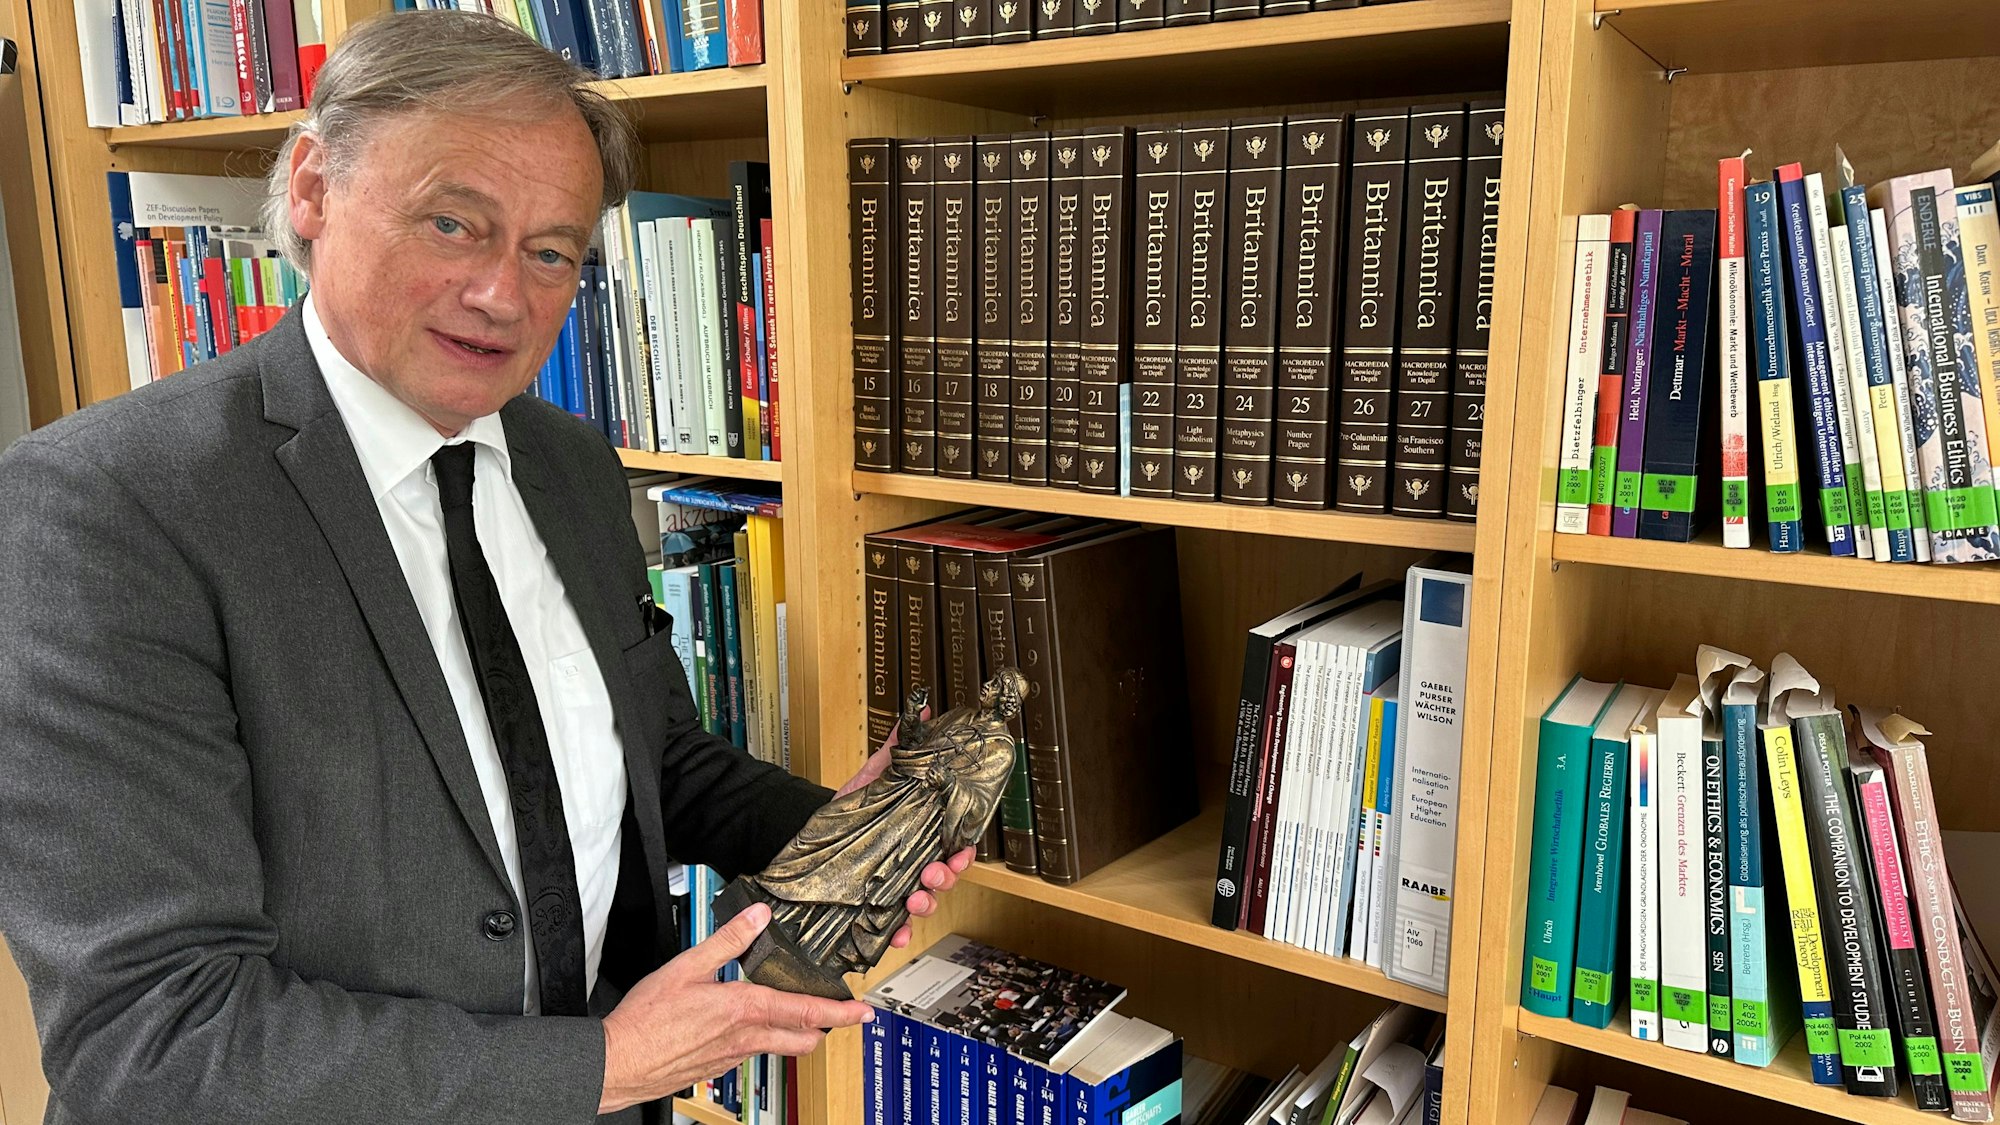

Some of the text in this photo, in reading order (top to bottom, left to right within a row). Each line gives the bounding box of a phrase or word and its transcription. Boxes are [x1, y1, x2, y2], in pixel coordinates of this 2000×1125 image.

[146, 204, 220, 214] ZEF-Discussion Papers
[1754, 191, 1771, 204] 19
[1849, 193, 1866, 206] 25
[158, 213, 201, 223] Development
[203, 214, 223, 223] Policy
[1727, 177, 1736, 255] Kampmann/Siebe/Walter
[1917, 194, 1937, 251] ENDERLE
[734, 184, 749, 303] Geschäftsplan Deutschland
[1359, 180, 1391, 330] Britannica
[1417, 177, 1449, 330] Britannica
[1020, 195, 1039, 325] Britannica
[1145, 190, 1169, 327] Britannica
[1190, 189, 1215, 328] Britannica
[1240, 187, 1267, 329] Britannica
[1295, 183, 1325, 329] Britannica
[1790, 202, 1817, 328] Kreikebaum/Behnam/Gilbert
[1579, 251, 1594, 354] Unternehmensethik
[1757, 230, 1778, 377] Unternehmensethik in der Praxis
[1856, 218, 1884, 384] Globalisierung, Ethik und Entwicklung
[1629, 231, 1655, 421] Held, Nutzinger: Nachhaltiges Naturkapital
[1669, 234, 1694, 401] Dettmar: Markt Macht Moral
[649, 314, 662, 381] DER BESCHLUSS
[1728, 261, 1739, 418] Mikroökonomie: Markt und Wettbewerb
[769, 360, 779, 383] Erwin
[1926, 274, 1965, 485] International Business Ethics
[1018, 385, 1035, 400] 19
[1142, 391, 1161, 407] 22
[1186, 393, 1205, 409] 23
[1235, 395, 1254, 412] 24
[1291, 396, 1311, 413] 25
[1878, 388, 1888, 409] Peter
[1353, 398, 1375, 415] 26
[1410, 400, 1432, 418] 27
[1572, 377, 1585, 460] Dietzfelbinger
[1806, 341, 1831, 485] international tätigen Unternehmen
[1816, 341, 1842, 483] Management ethischer Konflikte in
[1178, 434, 1213, 443] Metabolism
[1186, 425, 1203, 434] Light
[1226, 428, 1265, 438] Metaphysics
[1286, 430, 1313, 439] Number
[1397, 434, 1444, 445] San Francisco
[1232, 438, 1257, 448] Norway
[1287, 440, 1310, 450] Prague
[1352, 442, 1371, 451] Saint
[1403, 446, 1435, 455] Southern
[873, 588, 888, 697] Britannica
[708, 674, 718, 720] Biodiversity
[1419, 691, 1453, 704] PURSER
[1420, 681, 1454, 694] GAEBEL
[1415, 700, 1456, 715] WÄCHTER
[1417, 711, 1453, 726] WILSON
[1235, 700, 1253, 796] ADDIS ABABA 1886-1941
[1817, 732, 1827, 756] DESAI
[1411, 766, 1451, 781] Internatio-
[1774, 735, 1792, 800] Colin Leys
[1821, 761, 1833, 787] POTTER
[1412, 777, 1449, 791] nalisation
[1426, 788, 1434, 796] of
[1411, 795, 1448, 809] European
[1416, 805, 1442, 817] Higher
[1737, 717, 1750, 882] Globalisierung als politische Herausforderung
[1823, 792, 1840, 815] THE
[1410, 813, 1447, 828] Education
[1594, 751, 1615, 894] Arenhövel GLOBALES REGIEREN
[1640, 812, 1648, 844] ÖKONOMIE
[1676, 752, 1688, 897] Beckert: Grenzen des Marktes
[1546, 789, 1564, 902] Integrative Wirtschaftsethik
[1827, 816, 1850, 888] COMPANION
[1705, 755, 1724, 973] ON ETHICS & ECONOMICS SEN
[1874, 788, 1909, 945] THE HISTORY OF DEVELOPMENT
[1401, 877, 1447, 897] RAABE
[1839, 888, 1853, 906] TO
[1905, 754, 1922, 811] BOATRIGHT
[1915, 819, 1934, 872] ETHICS
[1926, 874, 1937, 894] AND
[1932, 915, 1955, 989] CONDUCT
[1948, 1007, 1967, 1055] BUSIN
[1406, 927, 1420, 937] AIV
[1406, 936, 1424, 947] 1060
[1543, 919, 1553, 944] Ulrich
[1639, 907, 1647, 958] FRAGWÜRDIGEN
[1741, 918, 1751, 975] Behrens (Hrsg.)
[1797, 934, 1812, 969] Theory
[1840, 908, 1865, 992] DEVELOPMENT
[1639, 959, 1647, 971] DIE
[1808, 932, 1825, 998] Development
[1532, 989, 1562, 1002] Haupt
[1742, 1002, 1755, 1011] Pol
[1741, 1011, 1757, 1020] 402
[1854, 992, 1872, 1030] STUDIE
[1736, 1019, 1762, 1029] 2005/1
[873, 1041, 883, 1065] GABLER
